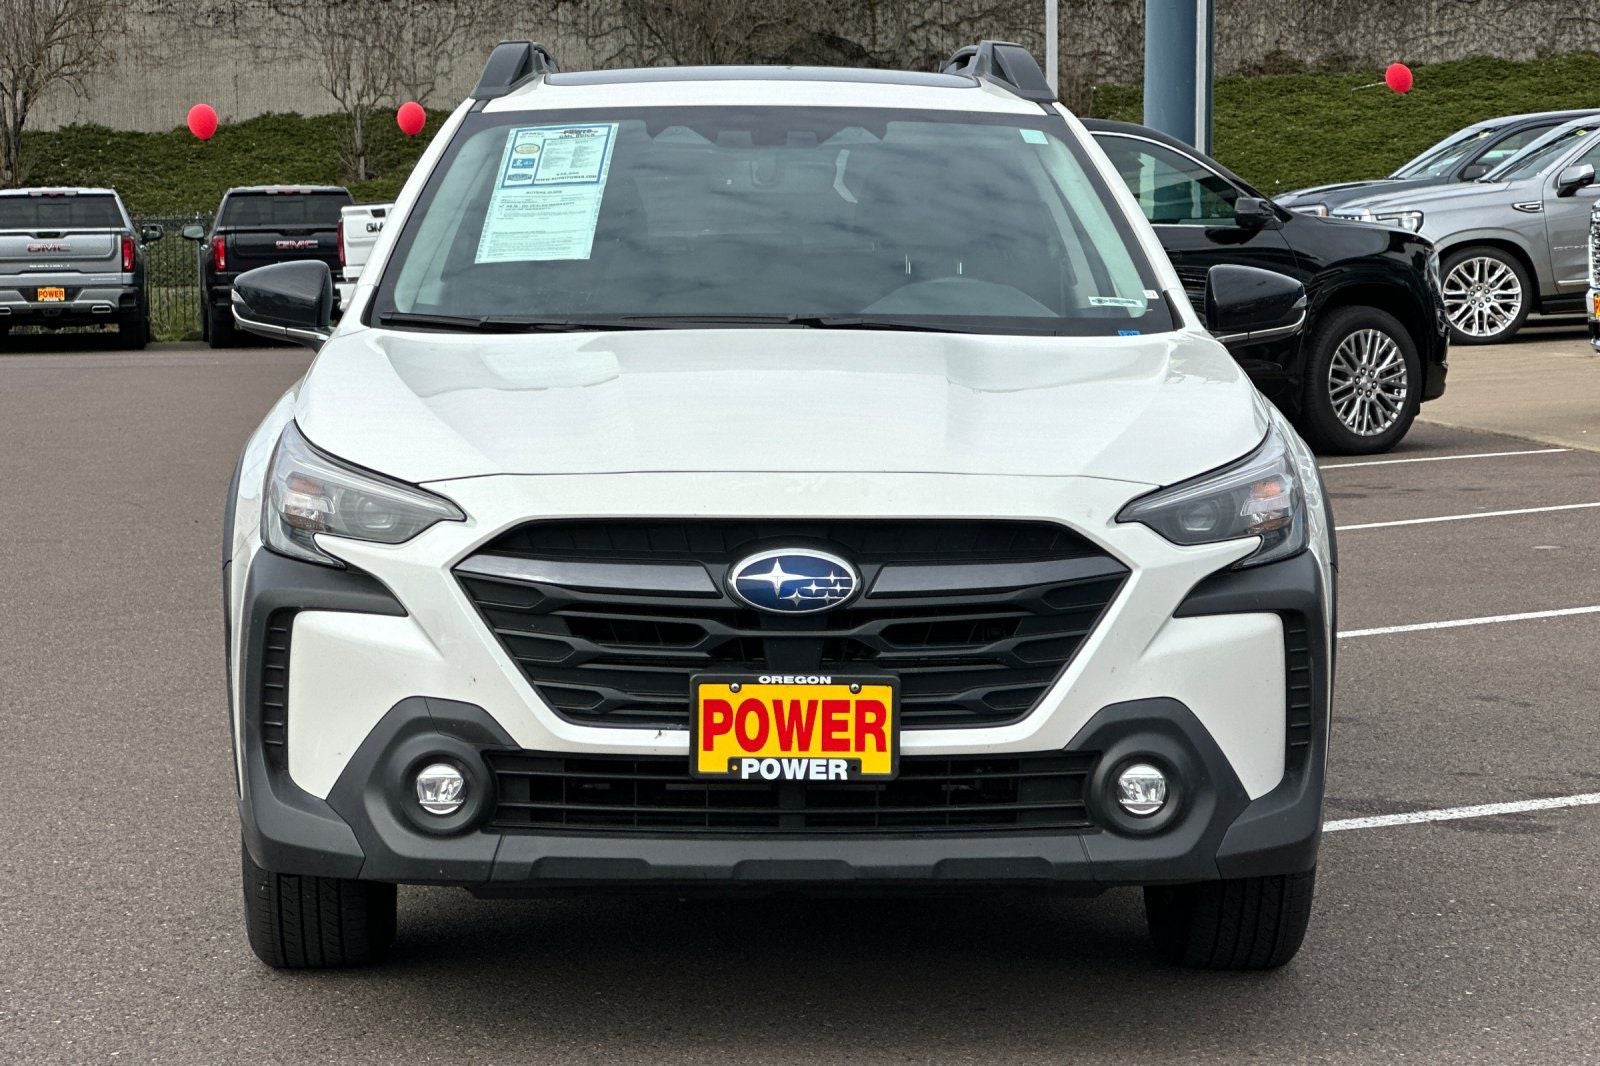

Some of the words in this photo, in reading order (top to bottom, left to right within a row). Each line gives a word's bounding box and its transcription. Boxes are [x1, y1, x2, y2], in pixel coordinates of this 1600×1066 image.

[27, 243, 71, 252] GMC
[276, 239, 318, 249] GMC
[38, 290, 64, 298] POWER
[758, 675, 832, 685] OREGON
[703, 698, 887, 752] POWER
[741, 758, 848, 780] POWER
